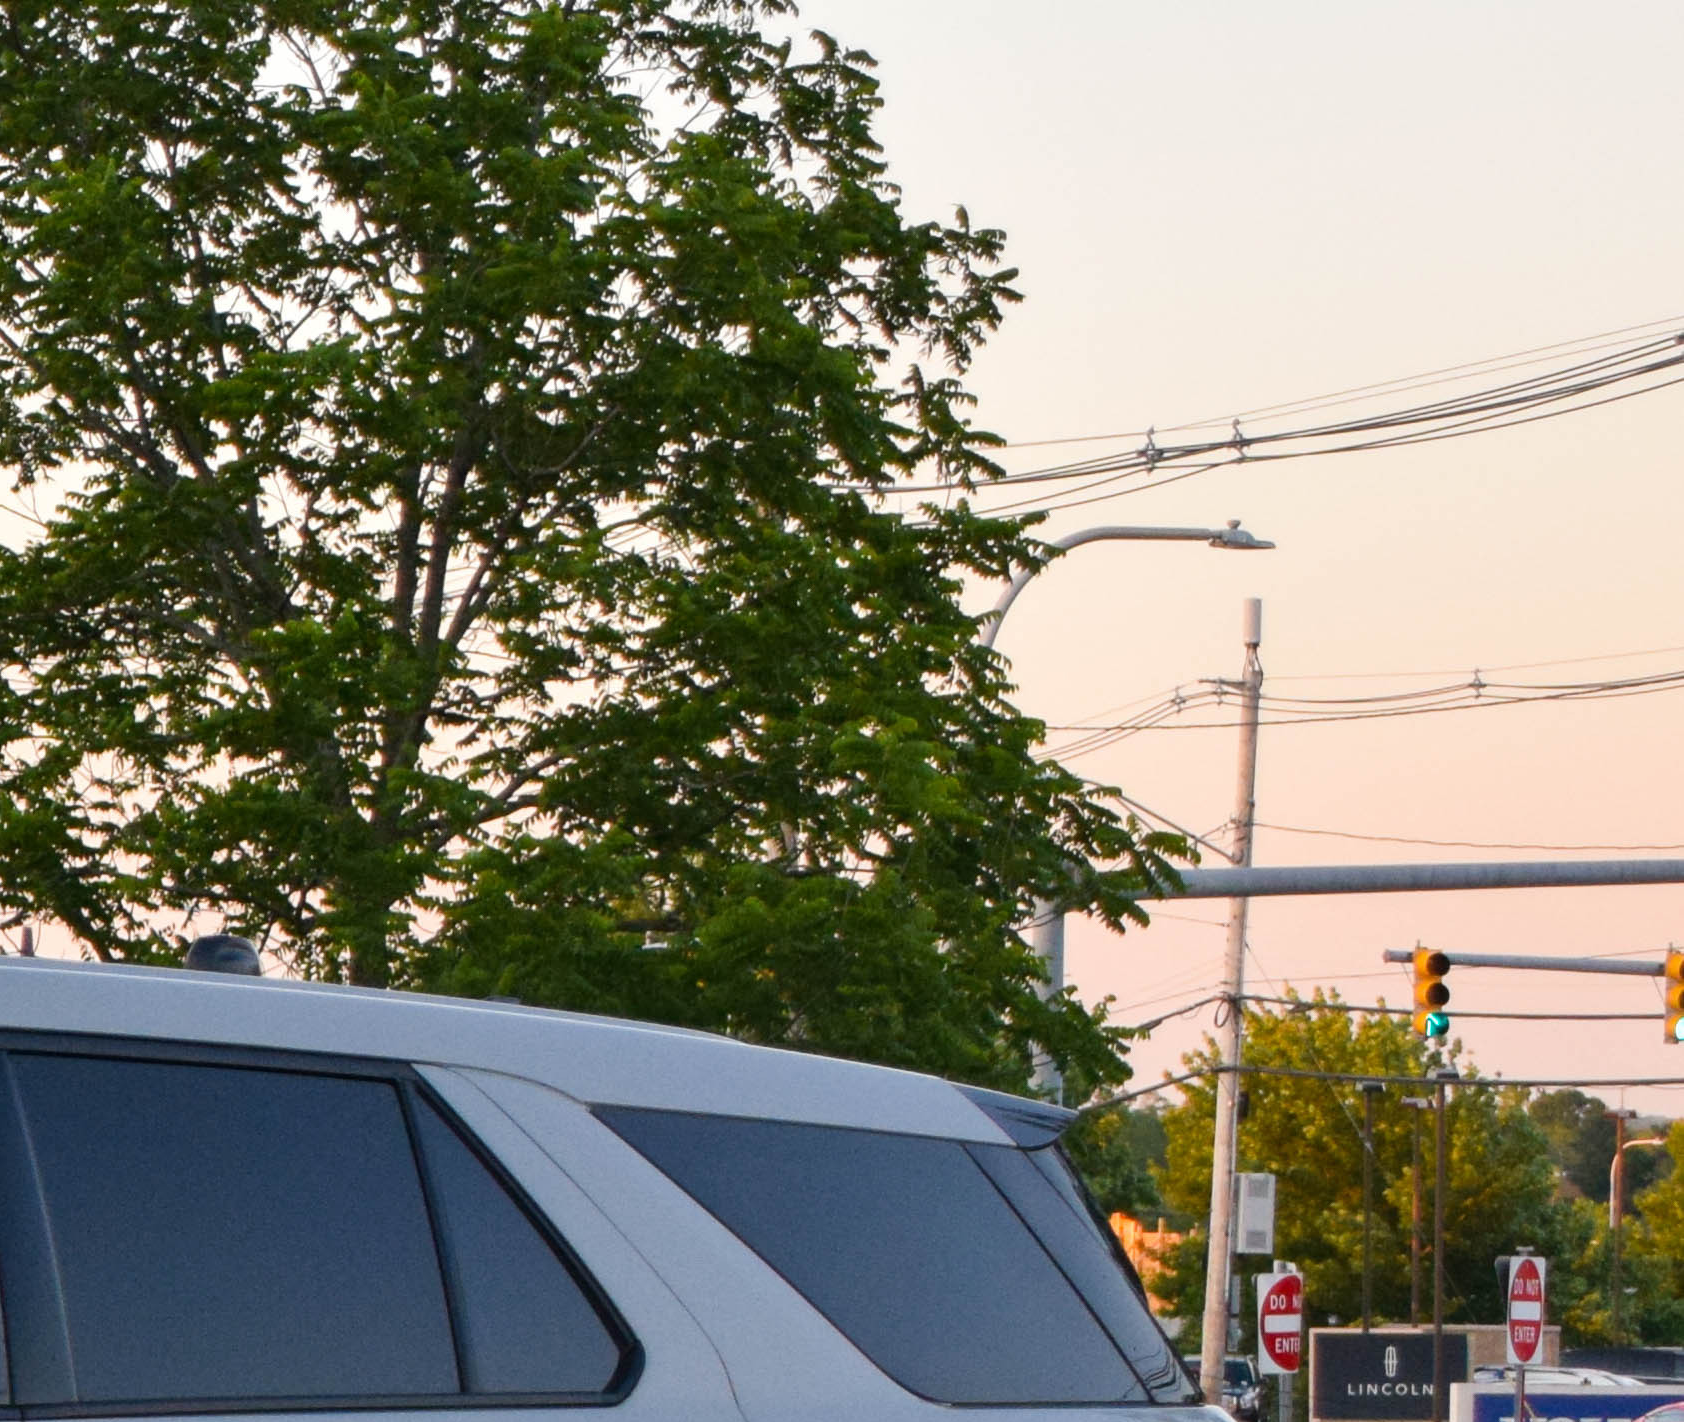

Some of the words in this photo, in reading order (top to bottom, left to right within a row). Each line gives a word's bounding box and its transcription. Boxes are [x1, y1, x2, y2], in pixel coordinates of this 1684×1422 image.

[1513, 1278, 1523, 1295] DO
[1270, 1294, 1286, 1310] DO
[1514, 1325, 1535, 1342] ENTER
[1347, 1383, 1434, 1396] LINCOLN
